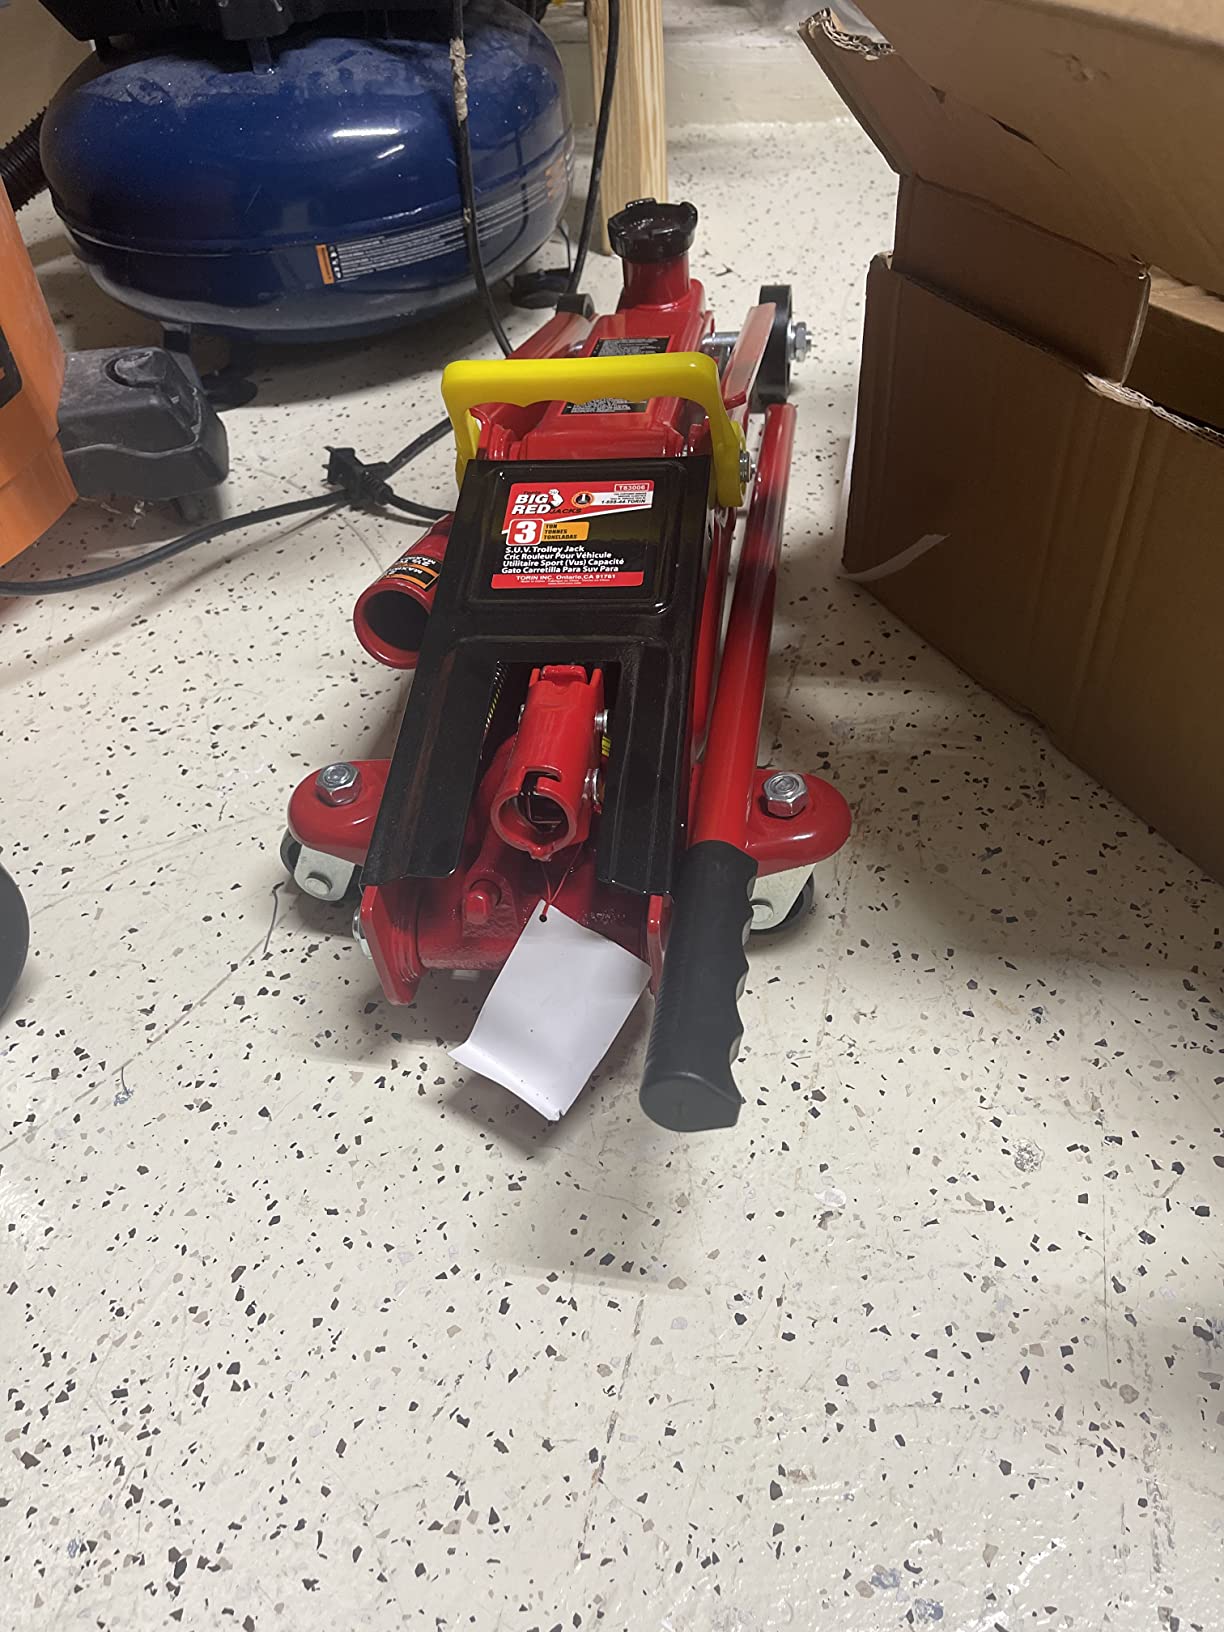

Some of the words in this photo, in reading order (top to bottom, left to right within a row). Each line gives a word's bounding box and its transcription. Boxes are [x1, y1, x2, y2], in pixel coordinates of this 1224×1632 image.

[514, 493, 549, 504] BIG
[511, 503, 551, 514] RED
[513, 520, 538, 543] 3
[532, 546, 563, 554] Trolley
[578, 551, 612, 559] Véhicule
[540, 559, 564, 567] Sport
[588, 558, 624, 566] Capacité
